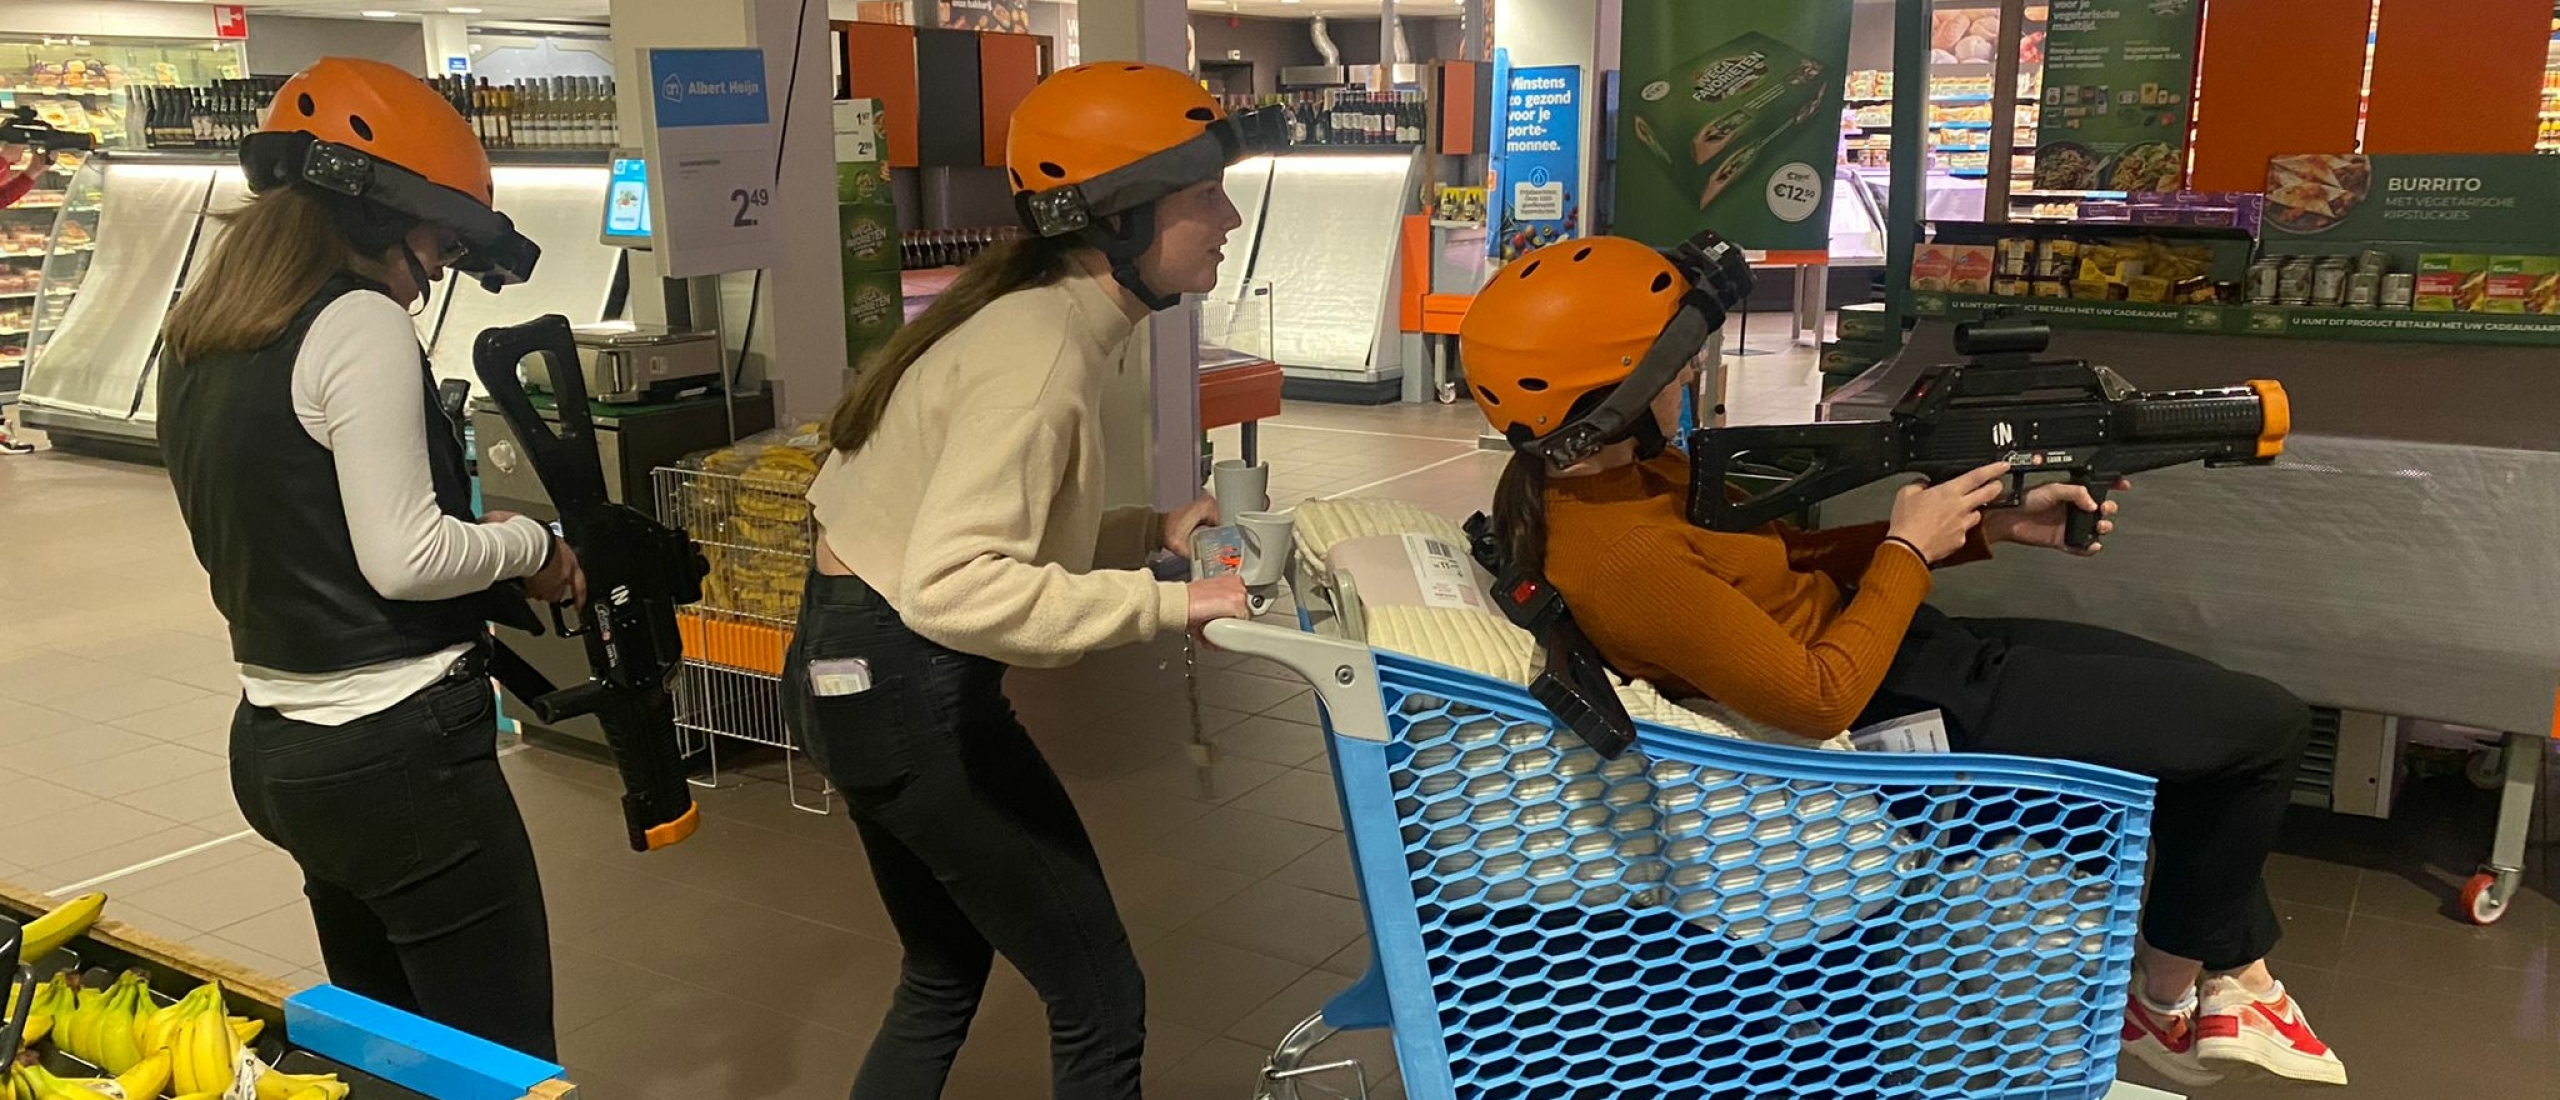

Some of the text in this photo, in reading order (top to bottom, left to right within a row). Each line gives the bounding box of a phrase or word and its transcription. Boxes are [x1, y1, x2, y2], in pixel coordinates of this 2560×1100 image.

[689, 79, 760, 96] Albert Heijn
[1510, 76, 1566, 91] Minstens
[1524, 90, 1571, 109] gezond
[1508, 106, 1551, 123] voor je
[1507, 124, 1547, 140] porte-
[1506, 140, 1561, 152] monnee.
[2387, 177, 2482, 192] BURRITO
[2385, 196, 2517, 208] MET VEGETARISCHE
[1960, 301, 1982, 309] KUNT
[2038, 305, 2077, 314] BETALEN
[2077, 307, 2096, 315] MET
[2096, 308, 2112, 316] UW
[2301, 318, 2328, 326] KUNT
[2329, 318, 2346, 326] DIT
[2346, 319, 2394, 328] PRODUCT
[2395, 320, 2440, 329] BETALEN
[2440, 321, 2462, 330] MET
[2464, 322, 2483, 331] UW
